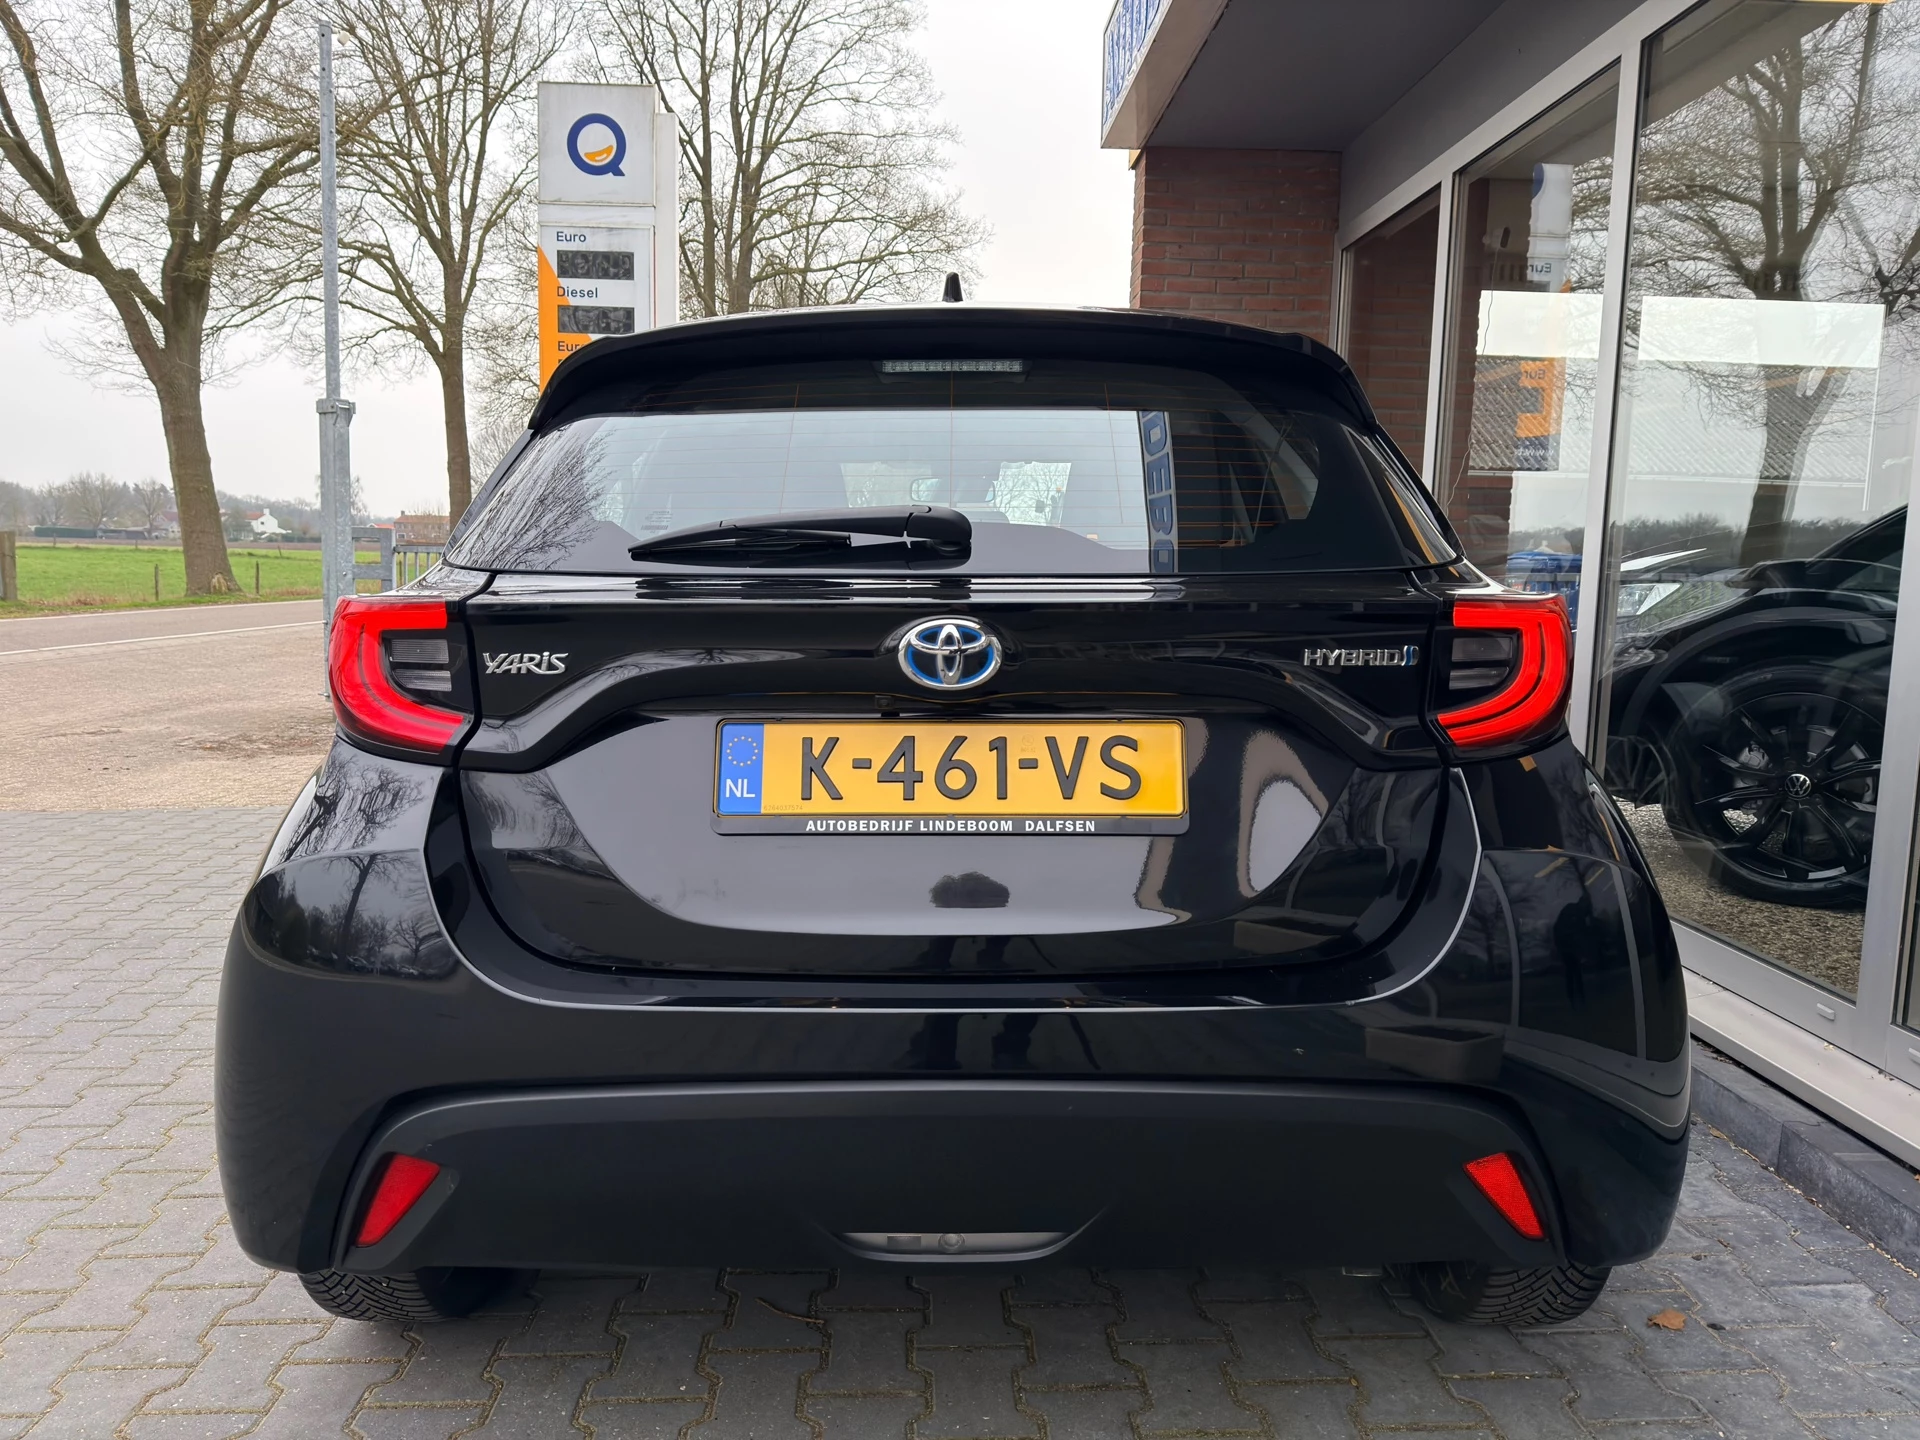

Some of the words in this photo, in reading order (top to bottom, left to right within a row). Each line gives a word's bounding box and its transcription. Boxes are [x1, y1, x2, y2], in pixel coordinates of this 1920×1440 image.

[556, 231, 587, 243] Euro
[557, 286, 598, 298] Diesel
[801, 735, 1142, 801] K-461-VS
[725, 779, 755, 798] NL
[806, 819, 914, 832] AUTOBEDRIJF
[919, 819, 1013, 832] LINDEBOOM
[1024, 819, 1096, 832] DALFSEN
